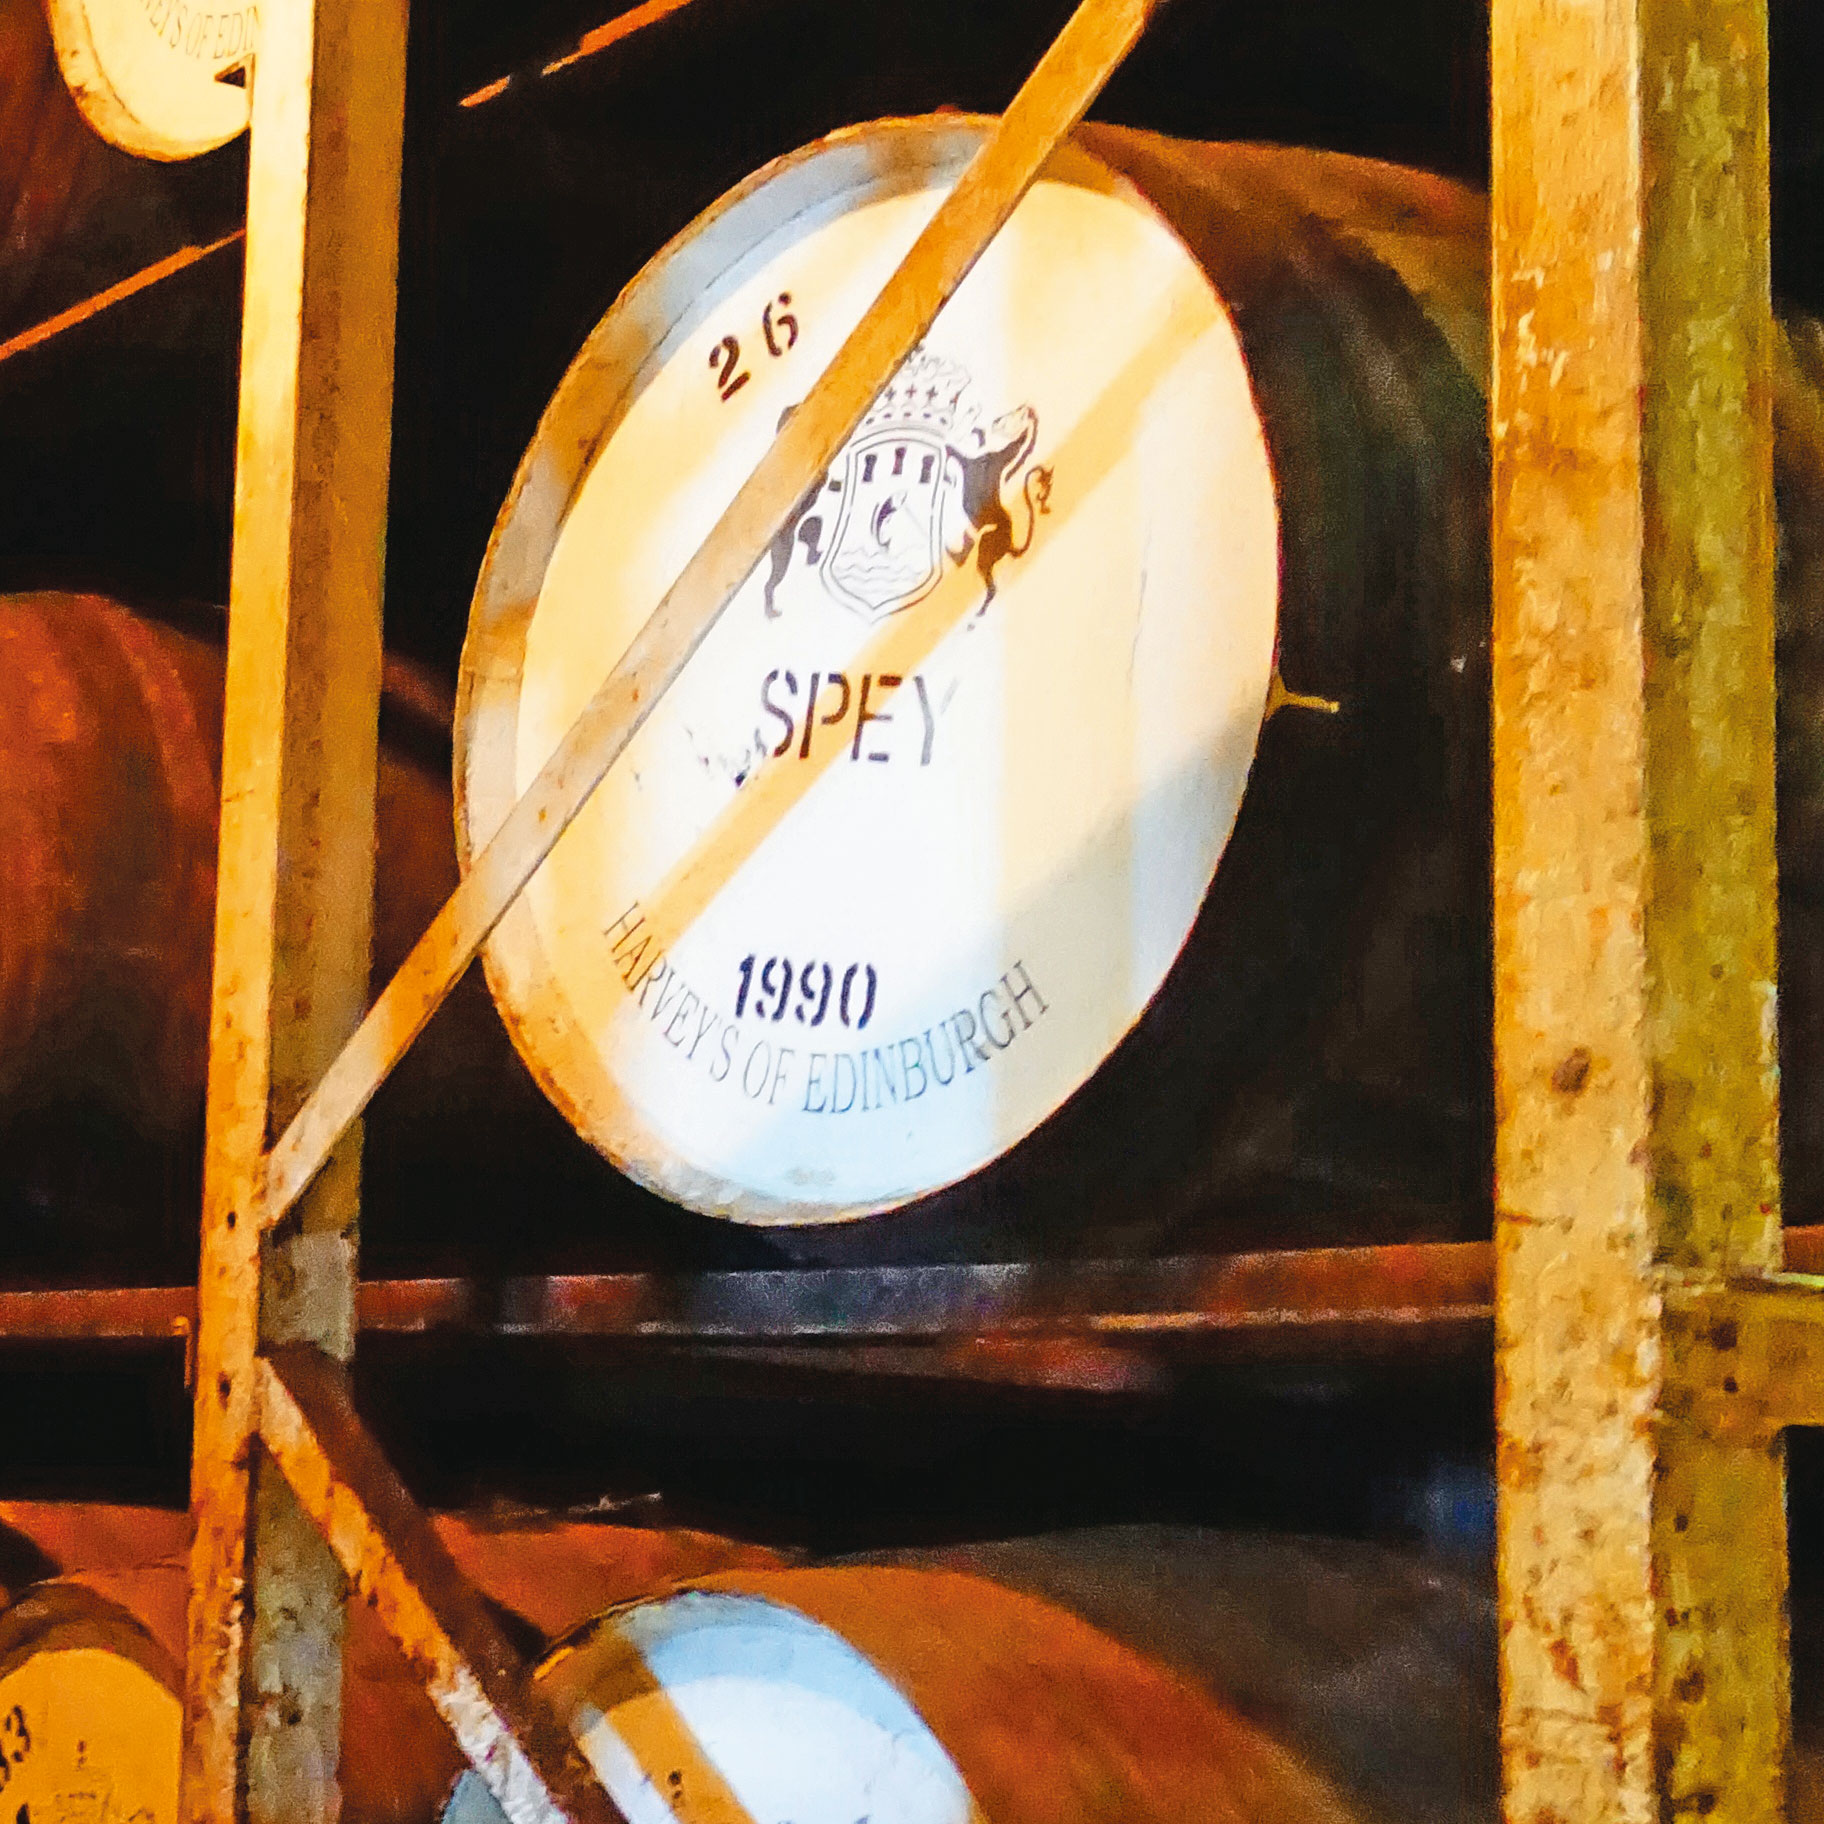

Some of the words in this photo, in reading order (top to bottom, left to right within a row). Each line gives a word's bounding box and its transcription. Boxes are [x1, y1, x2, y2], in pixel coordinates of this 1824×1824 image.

[709, 291, 798, 403] 26
[761, 670, 959, 766] SPEY
[603, 901, 739, 1082] HARVEY'S
[743, 1039, 795, 1106] OF
[802, 959, 1051, 1115] EDINBURGH
[735, 953, 878, 1029] 1990
